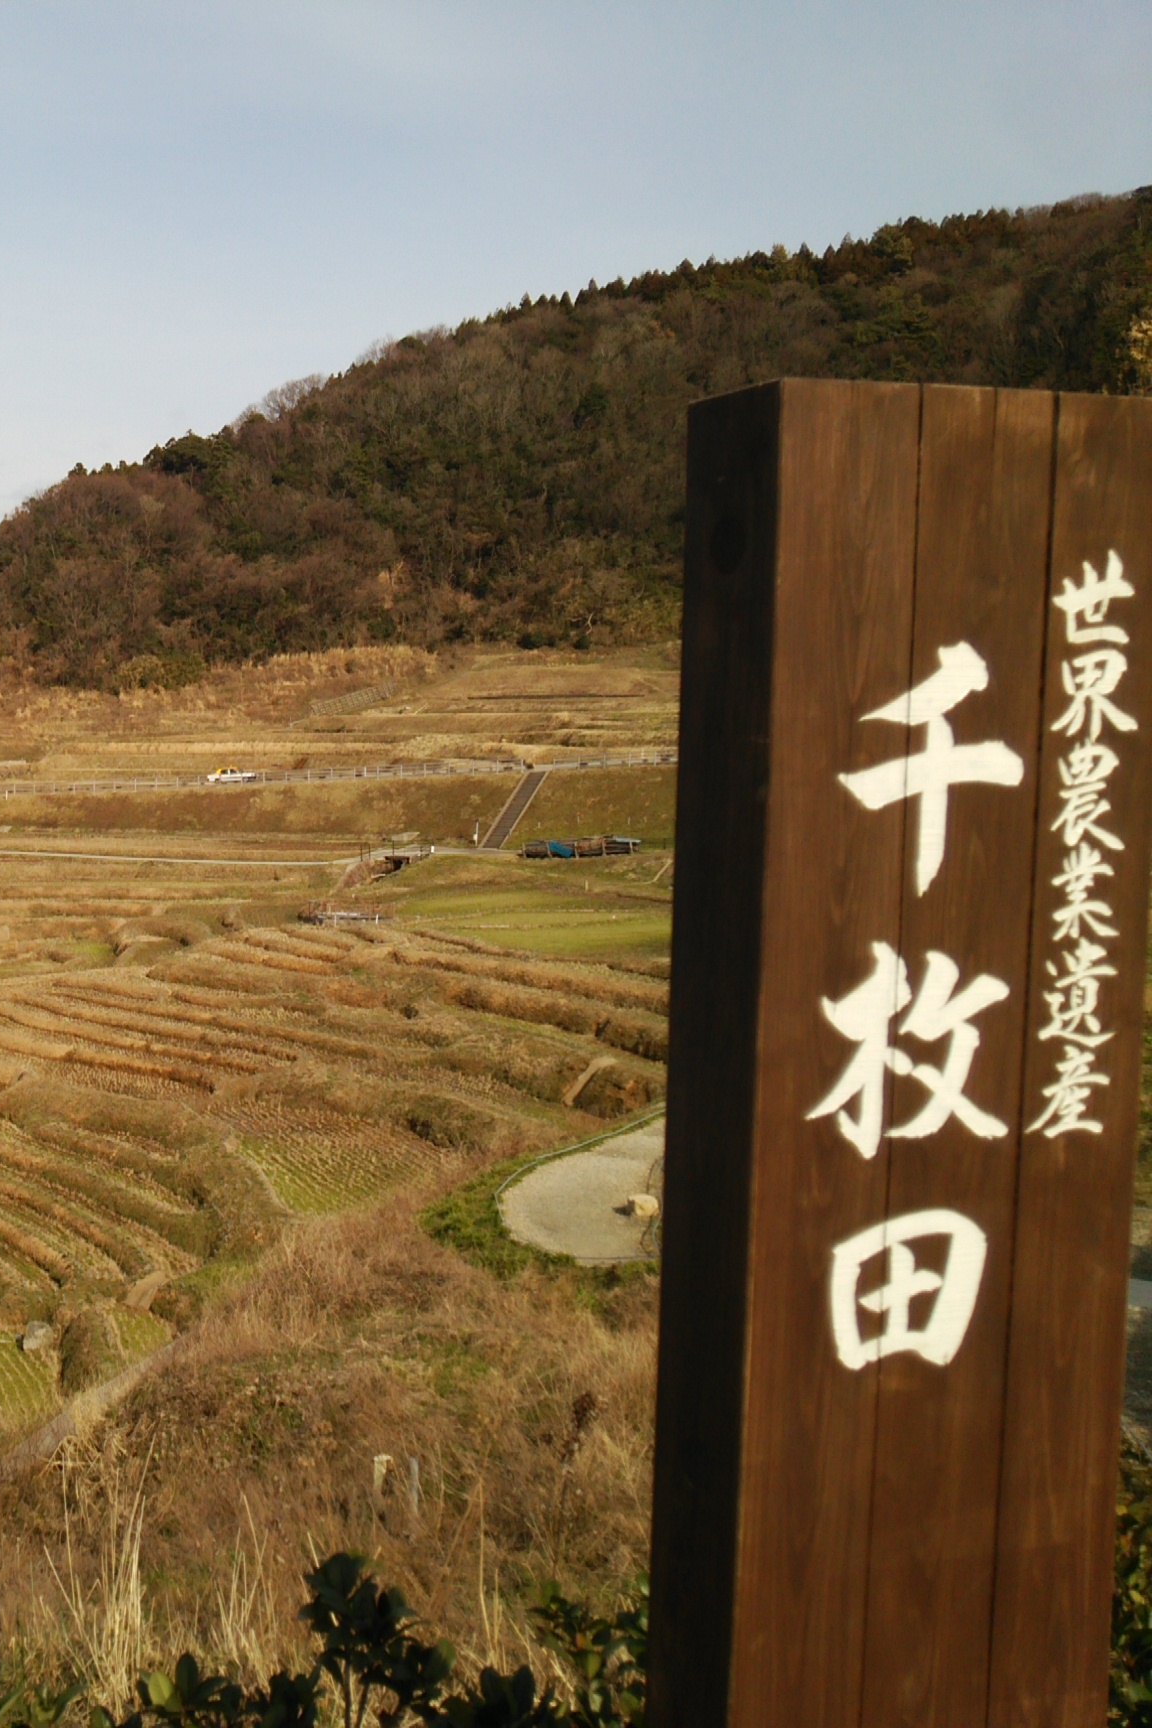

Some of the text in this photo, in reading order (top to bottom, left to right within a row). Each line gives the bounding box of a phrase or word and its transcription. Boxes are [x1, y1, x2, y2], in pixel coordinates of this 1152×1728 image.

[805, 640, 1025, 1371] 千枚田
[1026, 549, 1138, 1139] 世界農業遺産
